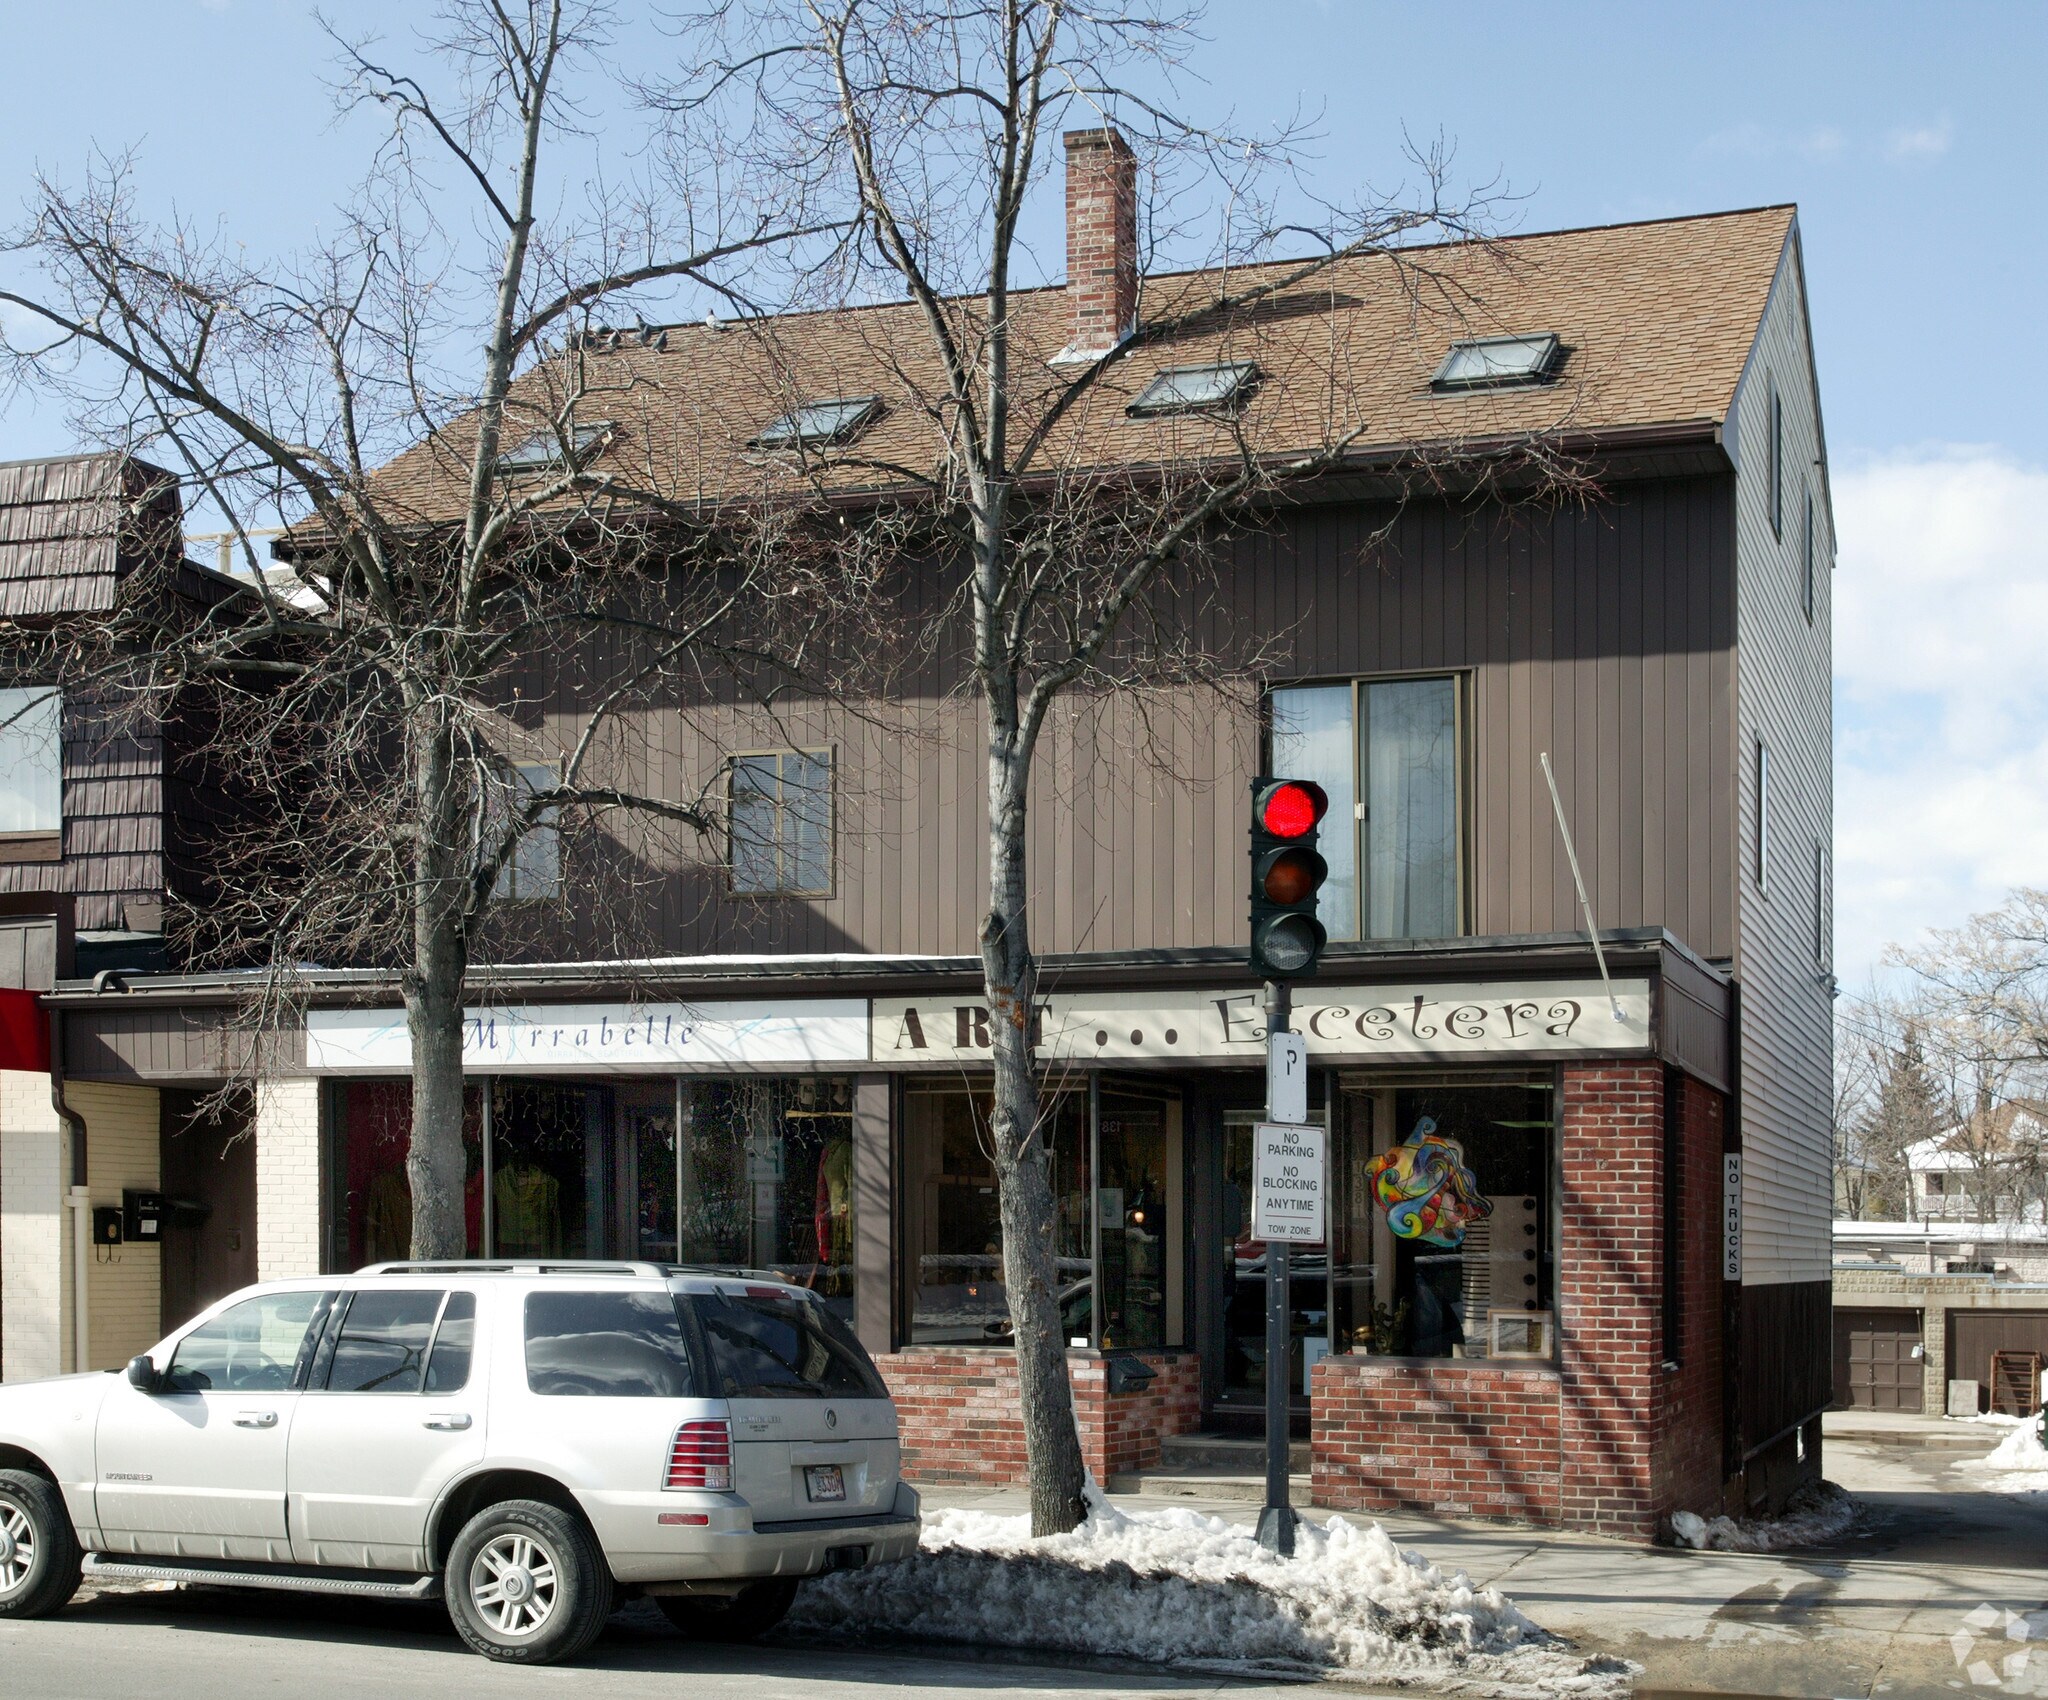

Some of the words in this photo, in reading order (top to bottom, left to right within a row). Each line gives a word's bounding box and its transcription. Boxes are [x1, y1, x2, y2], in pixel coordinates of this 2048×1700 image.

[1210, 994, 1582, 1044] Ecetera
[1283, 1132, 1300, 1144] NO
[1267, 1144, 1315, 1158] PARKING
[1282, 1166, 1299, 1178] NO
[1728, 1159, 1739, 1184] NO
[1262, 1177, 1318, 1191] BLOCKING
[1266, 1198, 1314, 1211] ANYTIME
[1267, 1224, 1287, 1234] TOW
[1290, 1225, 1312, 1235] ZONE
[1728, 1194, 1738, 1274] TRUCKS
